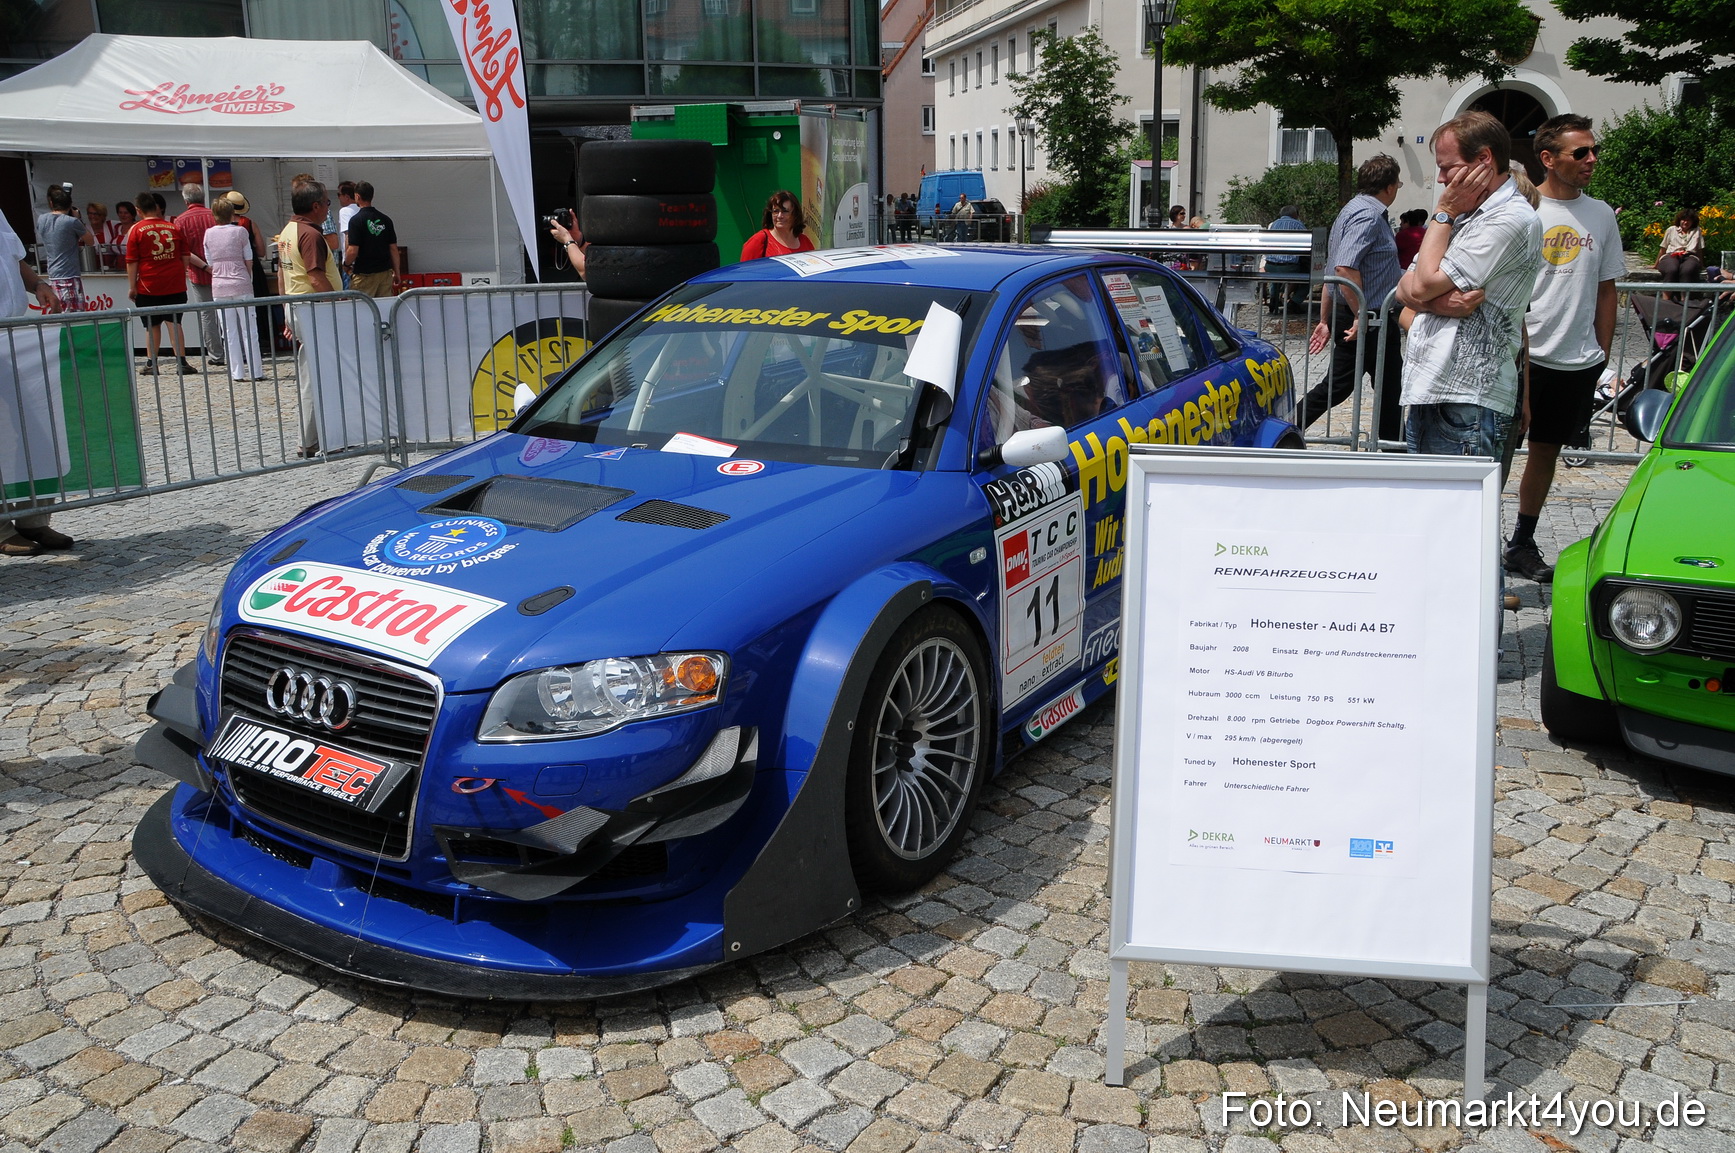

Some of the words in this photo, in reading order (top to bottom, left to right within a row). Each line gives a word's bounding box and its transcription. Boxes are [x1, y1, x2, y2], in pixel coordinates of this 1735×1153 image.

[119, 82, 285, 114] Lehmeier's
[220, 102, 284, 114] IMBISS
[146, 230, 176, 256] 33
[1560, 231, 1594, 251] Rock
[643, 304, 830, 328] Hohenester
[828, 310, 924, 336] Spor
[729, 463, 754, 471] E
[987, 470, 1047, 522] H&R
[430, 519, 498, 538] GUINNESS
[1094, 514, 1119, 558] Wir
[362, 529, 399, 556] Fastest
[394, 532, 420, 558] WORLD
[408, 542, 488, 562] RECORDS
[1232, 544, 1268, 557] DEKRA
[362, 554, 382, 566] car
[462, 542, 520, 568] biogas.
[371, 562, 434, 577] powered
[436, 562, 459, 574] by
[1214, 567, 1378, 581] RENNFAHRZEUGSCHAU
[284, 575, 468, 646] Castrol
[1026, 574, 1060, 648] 11
[1224, 621, 1238, 630] Typ
[1250, 618, 1318, 631] Hohenester
[1328, 621, 1356, 632] Audi
[1360, 622, 1376, 633] A4
[1380, 623, 1396, 634] B7
[1042, 642, 1065, 665] feldten
[1190, 643, 1218, 652] Baujahr
[1304, 648, 1324, 657] Berg-
[1340, 649, 1416, 660] Rundstreckenrennen
[1018, 674, 1036, 694] nano
[1042, 653, 1064, 677] extract
[1224, 668, 1254, 677] HS-Audi
[1188, 689, 1220, 698] Hubraum
[1270, 693, 1302, 703] Leistung
[1188, 713, 1218, 722] Drehzahl
[1270, 716, 1300, 725] Getriebe
[1306, 717, 1334, 727] Dogbox
[1336, 719, 1376, 728] Powershift
[1376, 721, 1406, 731] Schaltg.
[1260, 736, 1302, 746] (abgeregelt)
[1184, 757, 1206, 766] Tuned
[1208, 759, 1216, 768] by
[1232, 757, 1288, 768] Hohenester
[1290, 759, 1316, 771] Sport
[236, 756, 256, 770] RACE
[256, 763, 270, 774] AND
[271, 768, 322, 791] PERFORMANCE
[324, 786, 356, 802] WHEELS
[1224, 782, 1284, 792] Unterschiedliche
[1202, 831, 1234, 843] DEKRA
[1264, 836, 1312, 847] NEUMARKT
